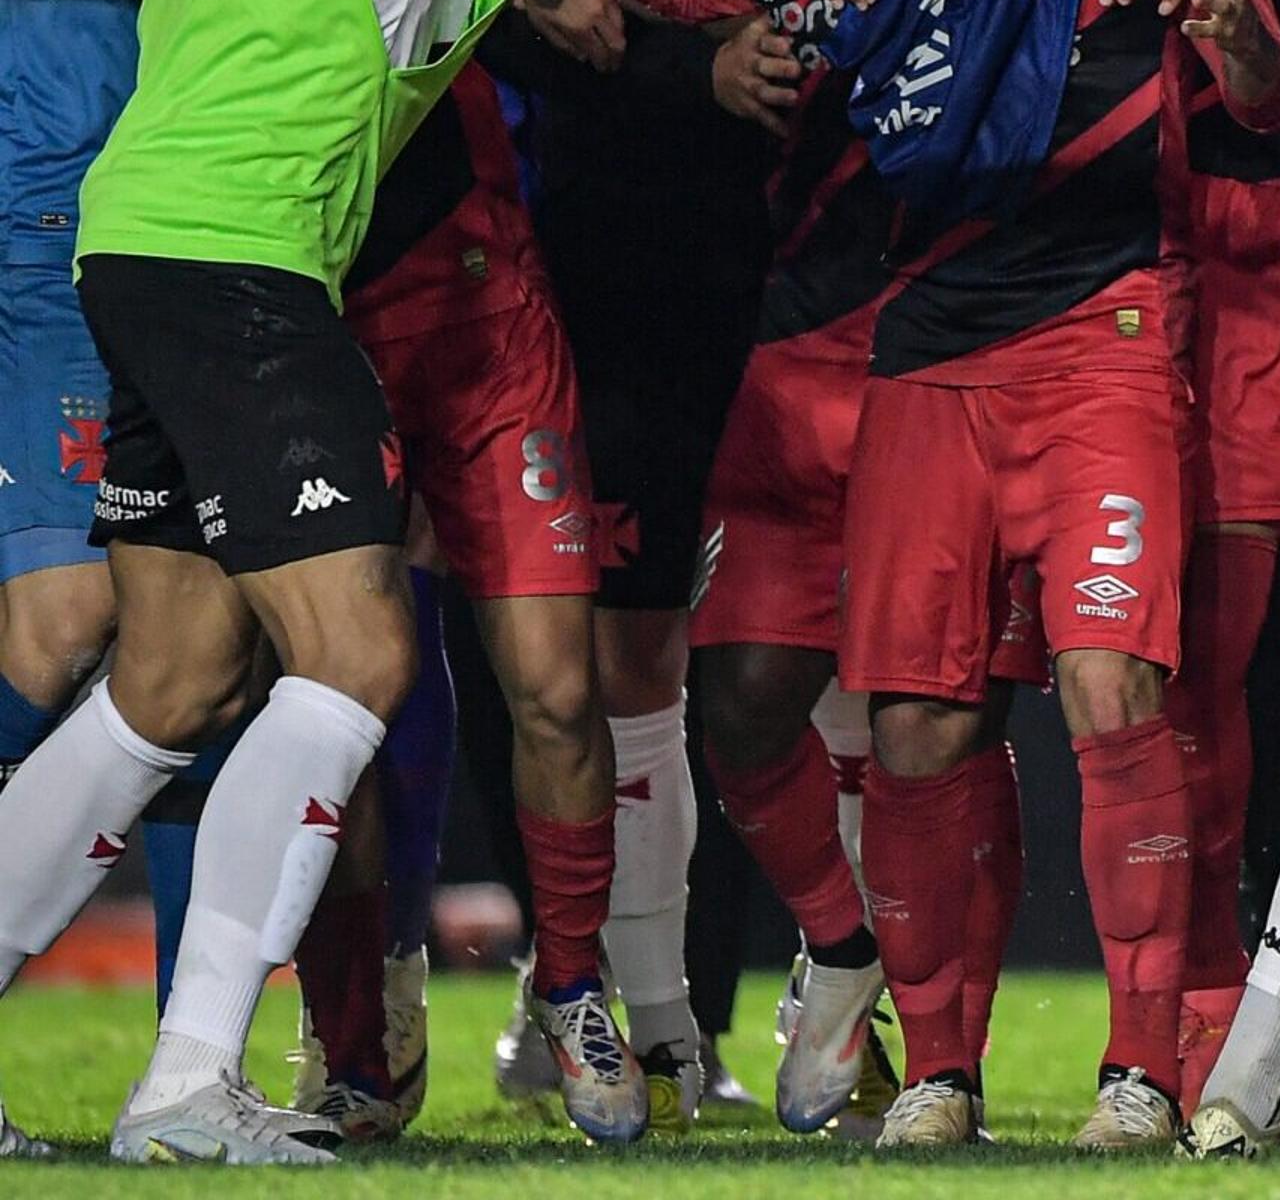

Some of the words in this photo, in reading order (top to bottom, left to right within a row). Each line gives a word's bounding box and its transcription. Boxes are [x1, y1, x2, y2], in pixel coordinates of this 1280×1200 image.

[521, 430, 569, 502] 8
[1091, 493, 1145, 566] 3
[1076, 603, 1128, 621] umbro
